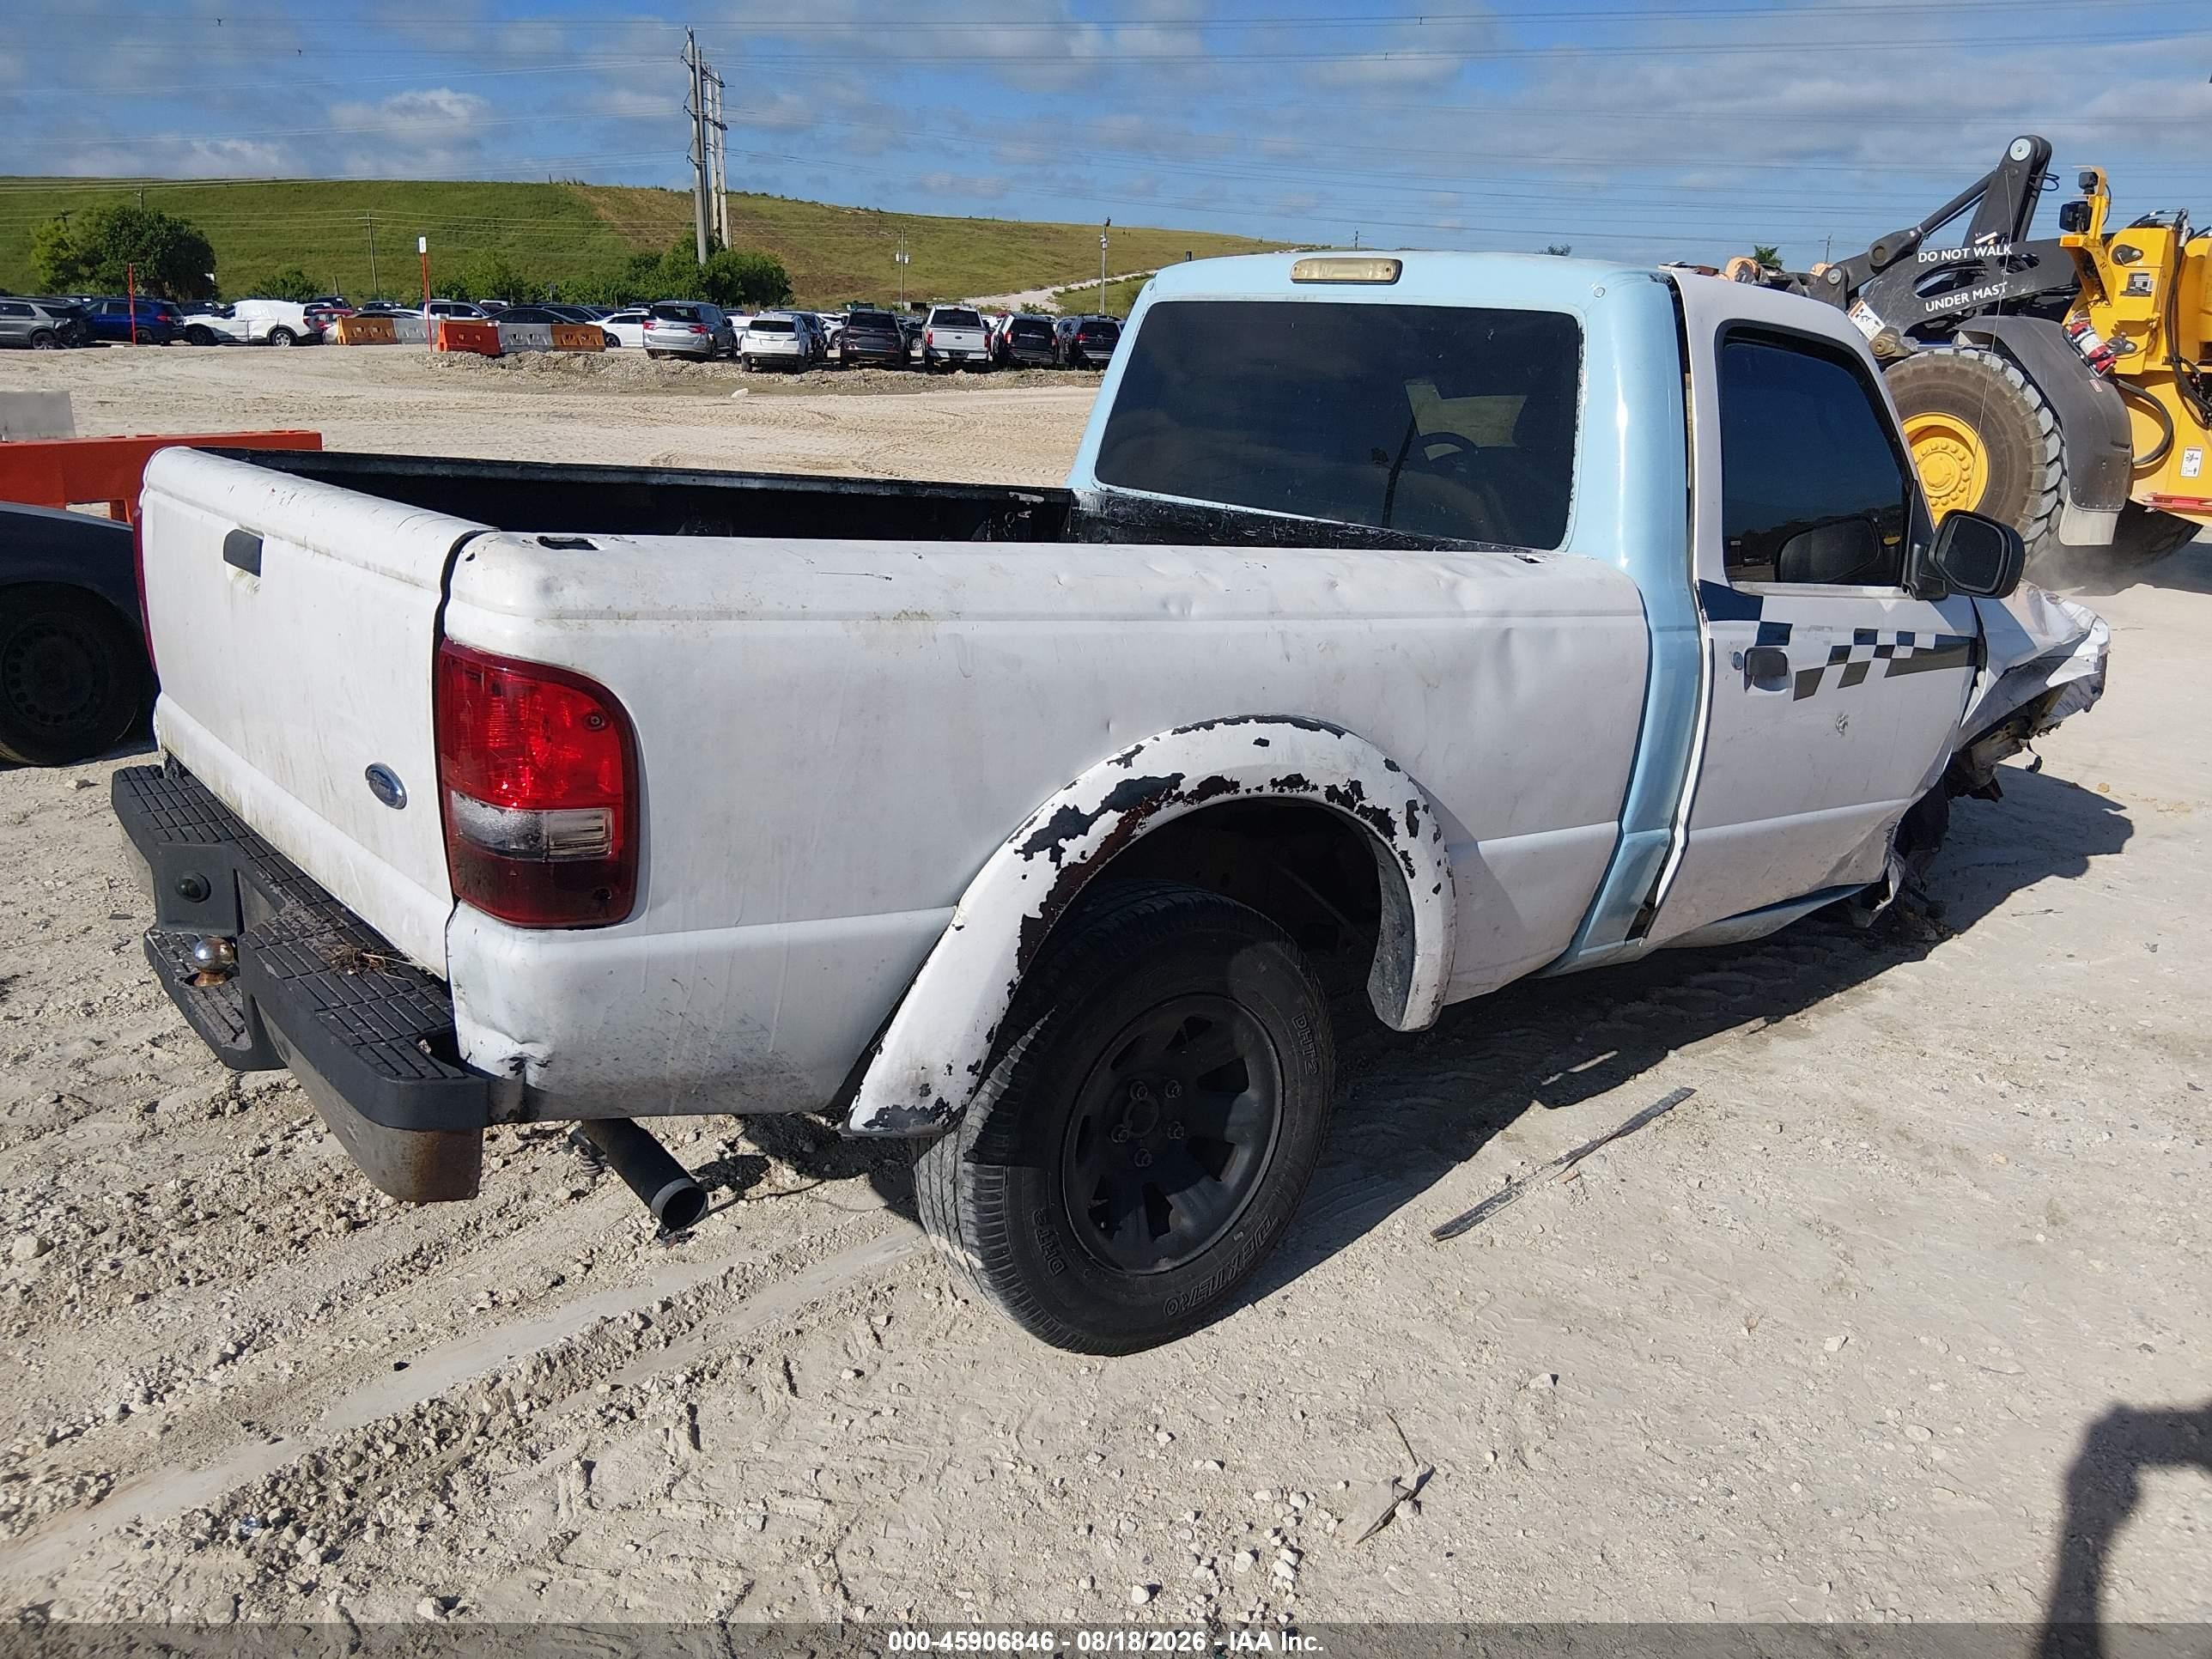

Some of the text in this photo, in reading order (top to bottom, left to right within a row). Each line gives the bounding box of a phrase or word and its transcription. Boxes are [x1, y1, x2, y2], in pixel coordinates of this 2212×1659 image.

[1918, 244, 2013, 263] DO NOT WALK
[1925, 282, 2008, 313] UNDER MAST
[1164, 1215, 1279, 1317] DEXTERO
